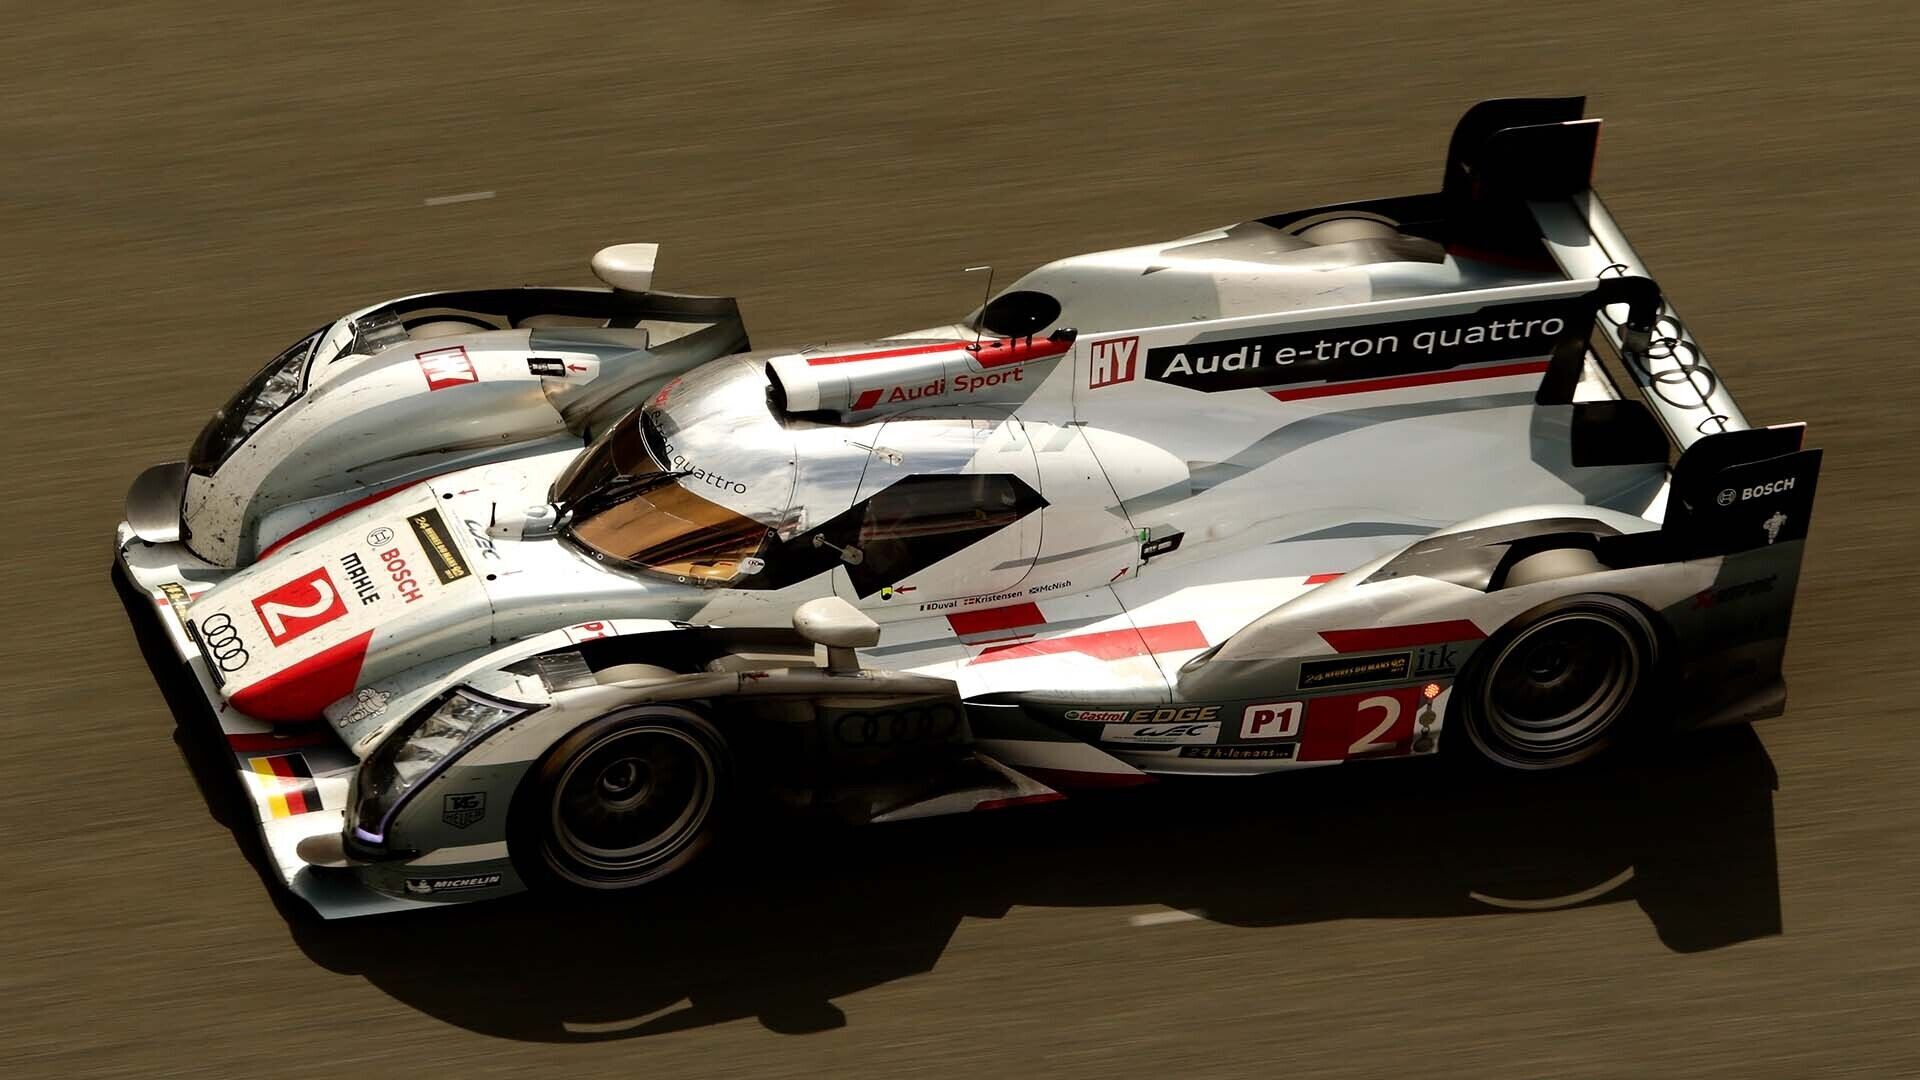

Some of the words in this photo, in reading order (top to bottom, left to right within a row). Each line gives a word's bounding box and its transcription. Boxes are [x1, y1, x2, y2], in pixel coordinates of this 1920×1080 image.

[1161, 345, 1262, 378] Audi
[1275, 335, 1398, 364] e-tron
[1413, 317, 1564, 354] quattro
[1091, 339, 1137, 385] HY
[888, 379, 945, 403] Audi
[954, 367, 1023, 393] Sport
[673, 455, 747, 494] quattro
[1742, 477, 1795, 500] BOSCH
[414, 516, 430, 530] 24
[340, 552, 381, 606] MAHLE
[380, 547, 424, 604] BOSCH
[1039, 580, 1072, 593] McNish
[260, 578, 334, 638] 2
[932, 600, 958, 611] Duval
[975, 590, 1023, 604] Kristensen
[1079, 711, 1125, 721] Castrol
[1129, 706, 1223, 723] EDGE
[1250, 708, 1294, 734] P1
[1348, 696, 1401, 754] 2
[1134, 724, 1209, 737] WEC
[433, 875, 500, 888] MICHELIN
